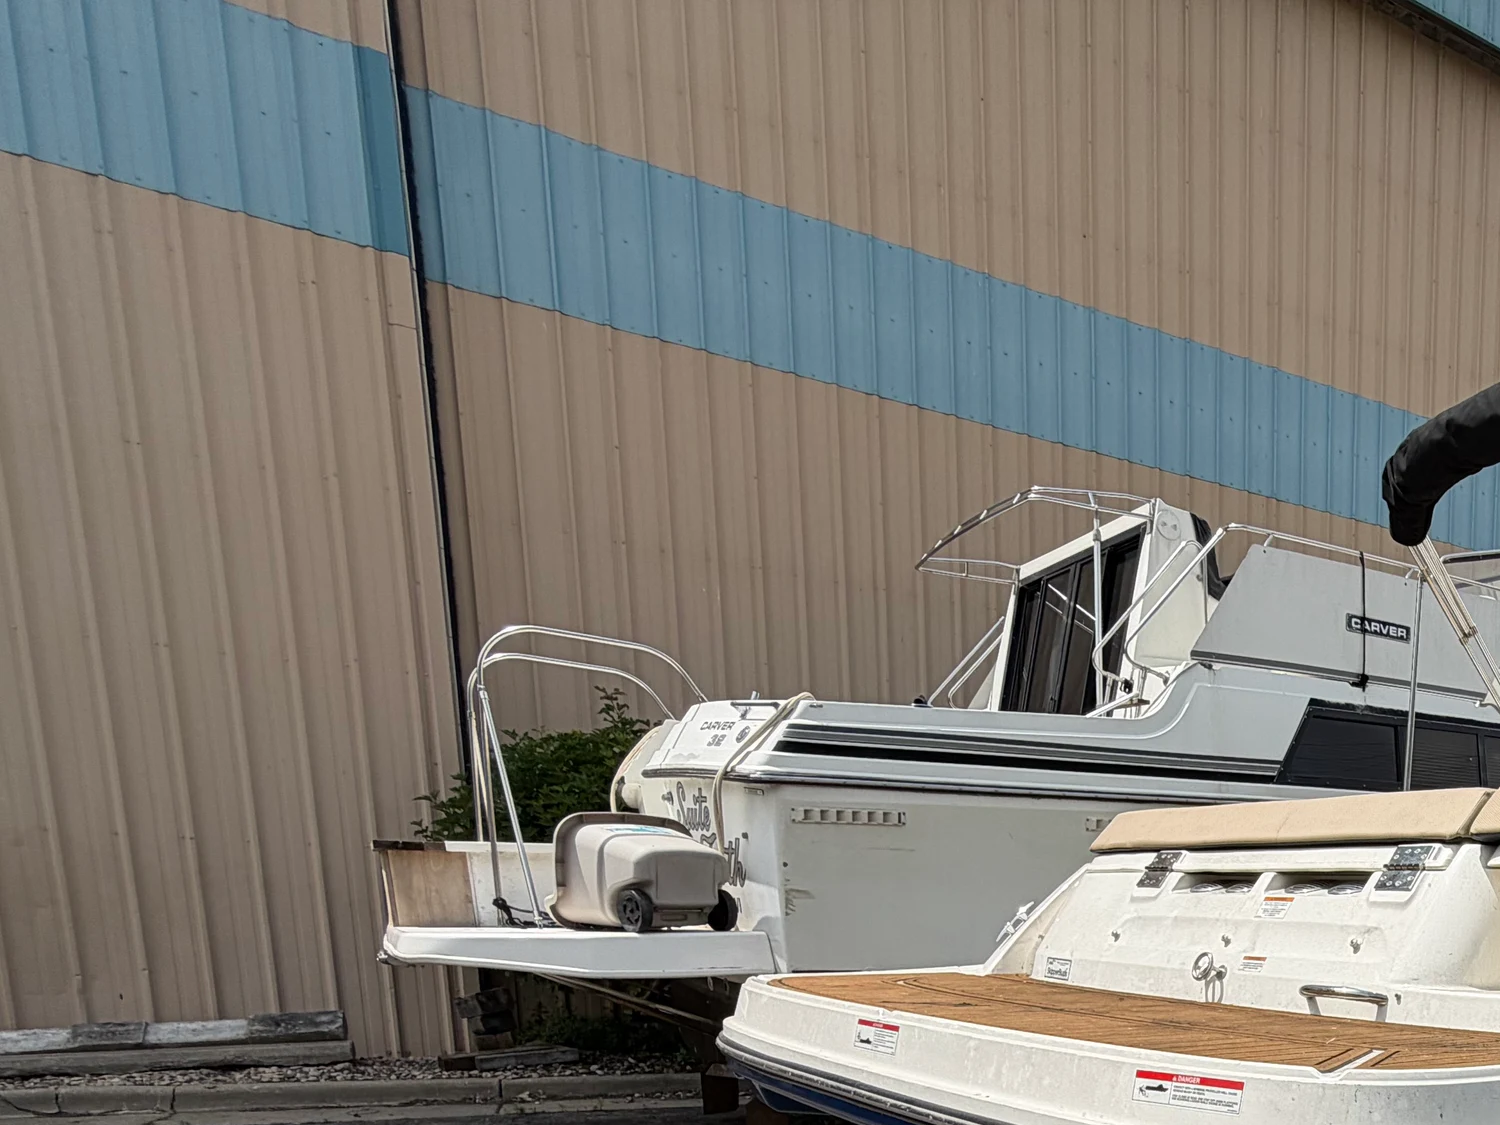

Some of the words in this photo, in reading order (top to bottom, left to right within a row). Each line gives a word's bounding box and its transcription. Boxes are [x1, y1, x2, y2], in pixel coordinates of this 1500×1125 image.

[1351, 618, 1407, 639] CARVER
[700, 721, 736, 731] CARVER
[1178, 1075, 1201, 1084] DANGER
